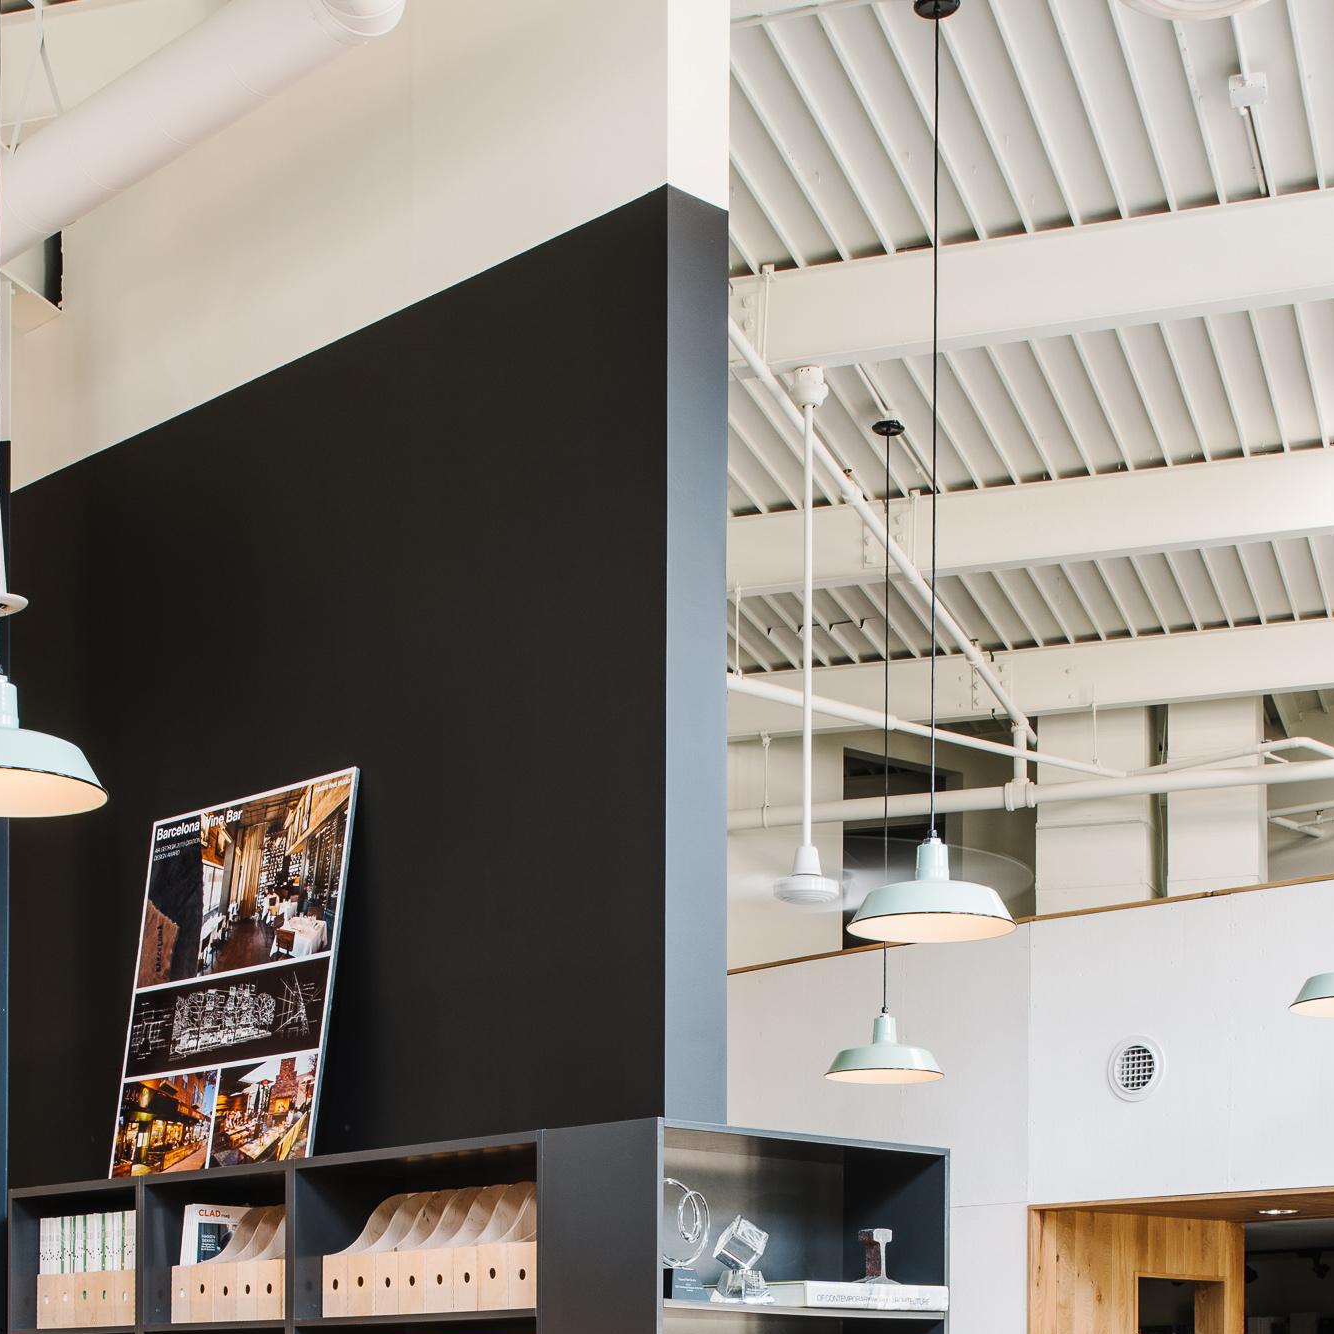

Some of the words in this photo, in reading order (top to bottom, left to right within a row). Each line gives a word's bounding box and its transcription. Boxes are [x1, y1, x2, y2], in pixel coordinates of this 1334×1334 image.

[157, 821, 200, 841] Barcelona
[226, 809, 243, 822] Bar
[199, 1209, 221, 1217] CLAD
